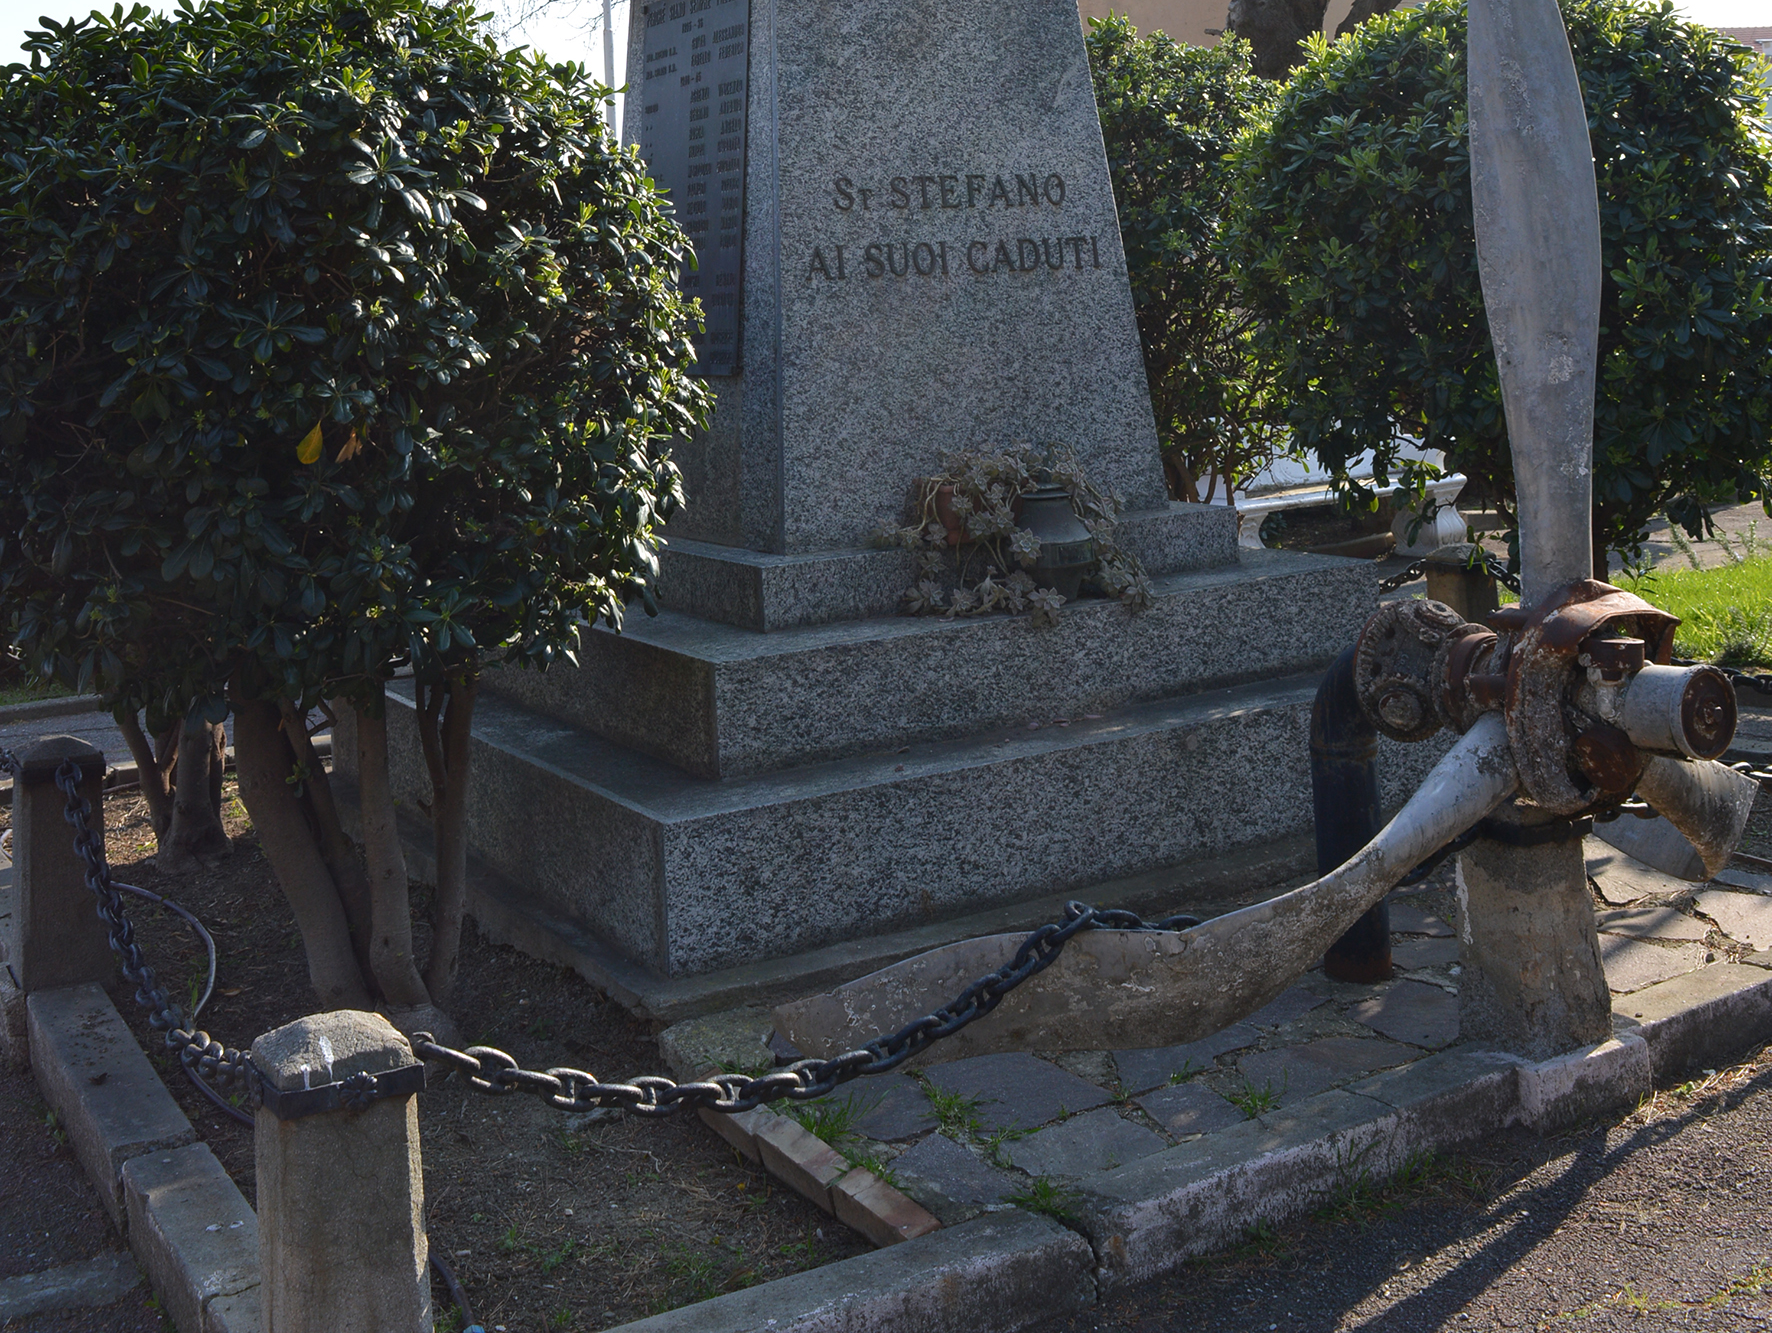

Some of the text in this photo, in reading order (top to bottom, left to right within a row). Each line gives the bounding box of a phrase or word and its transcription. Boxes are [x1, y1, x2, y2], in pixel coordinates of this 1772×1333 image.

[889, 174, 1067, 210] STEFANO
[805, 235, 1101, 281] AI SUOI CADUTI
